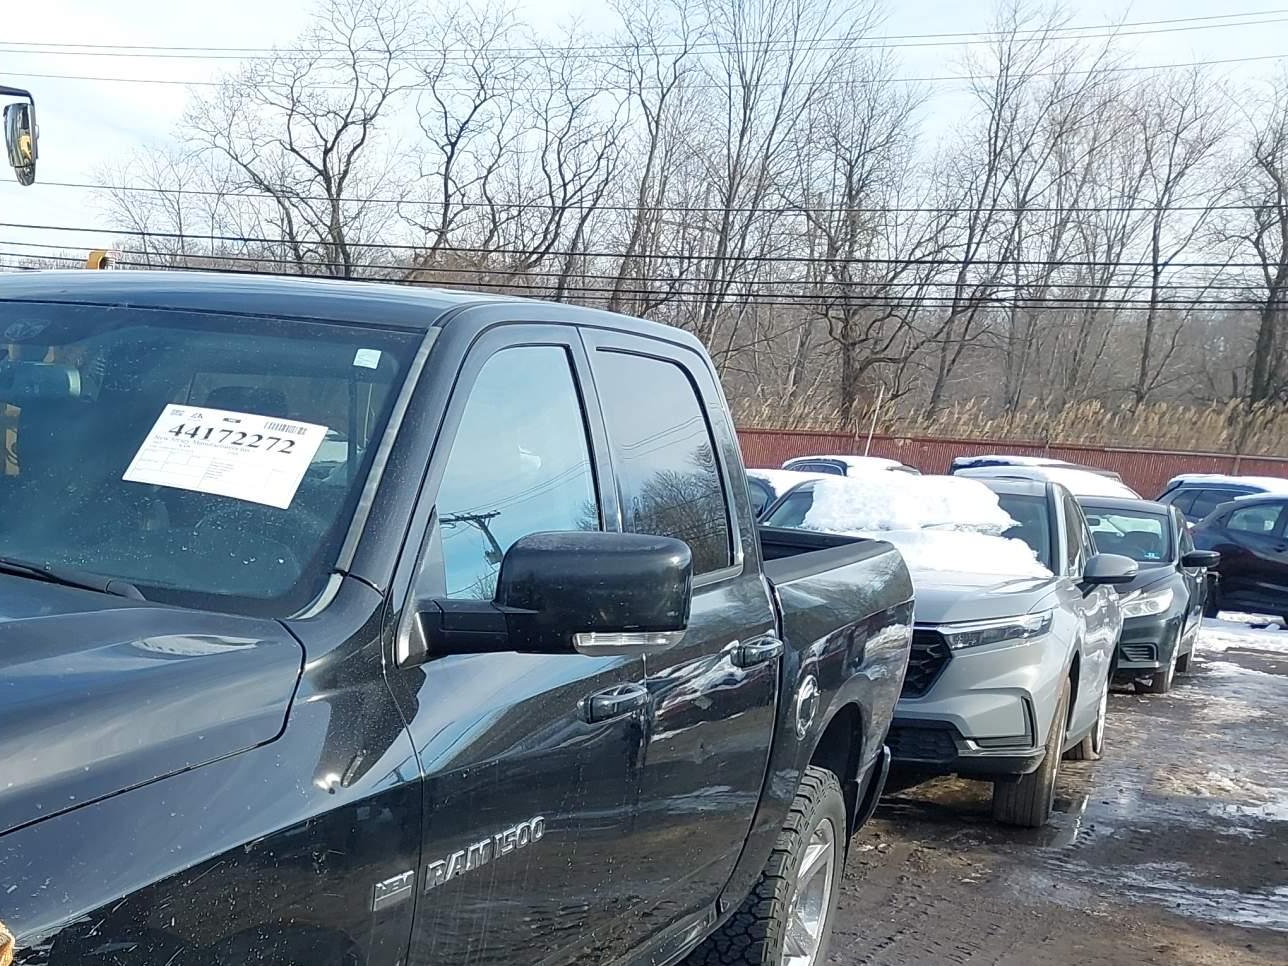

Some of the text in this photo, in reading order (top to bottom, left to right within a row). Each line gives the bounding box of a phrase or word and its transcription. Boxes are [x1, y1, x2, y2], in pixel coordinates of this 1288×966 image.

[168, 423, 296, 455] 44172272
[424, 815, 546, 893] RAM 1500
